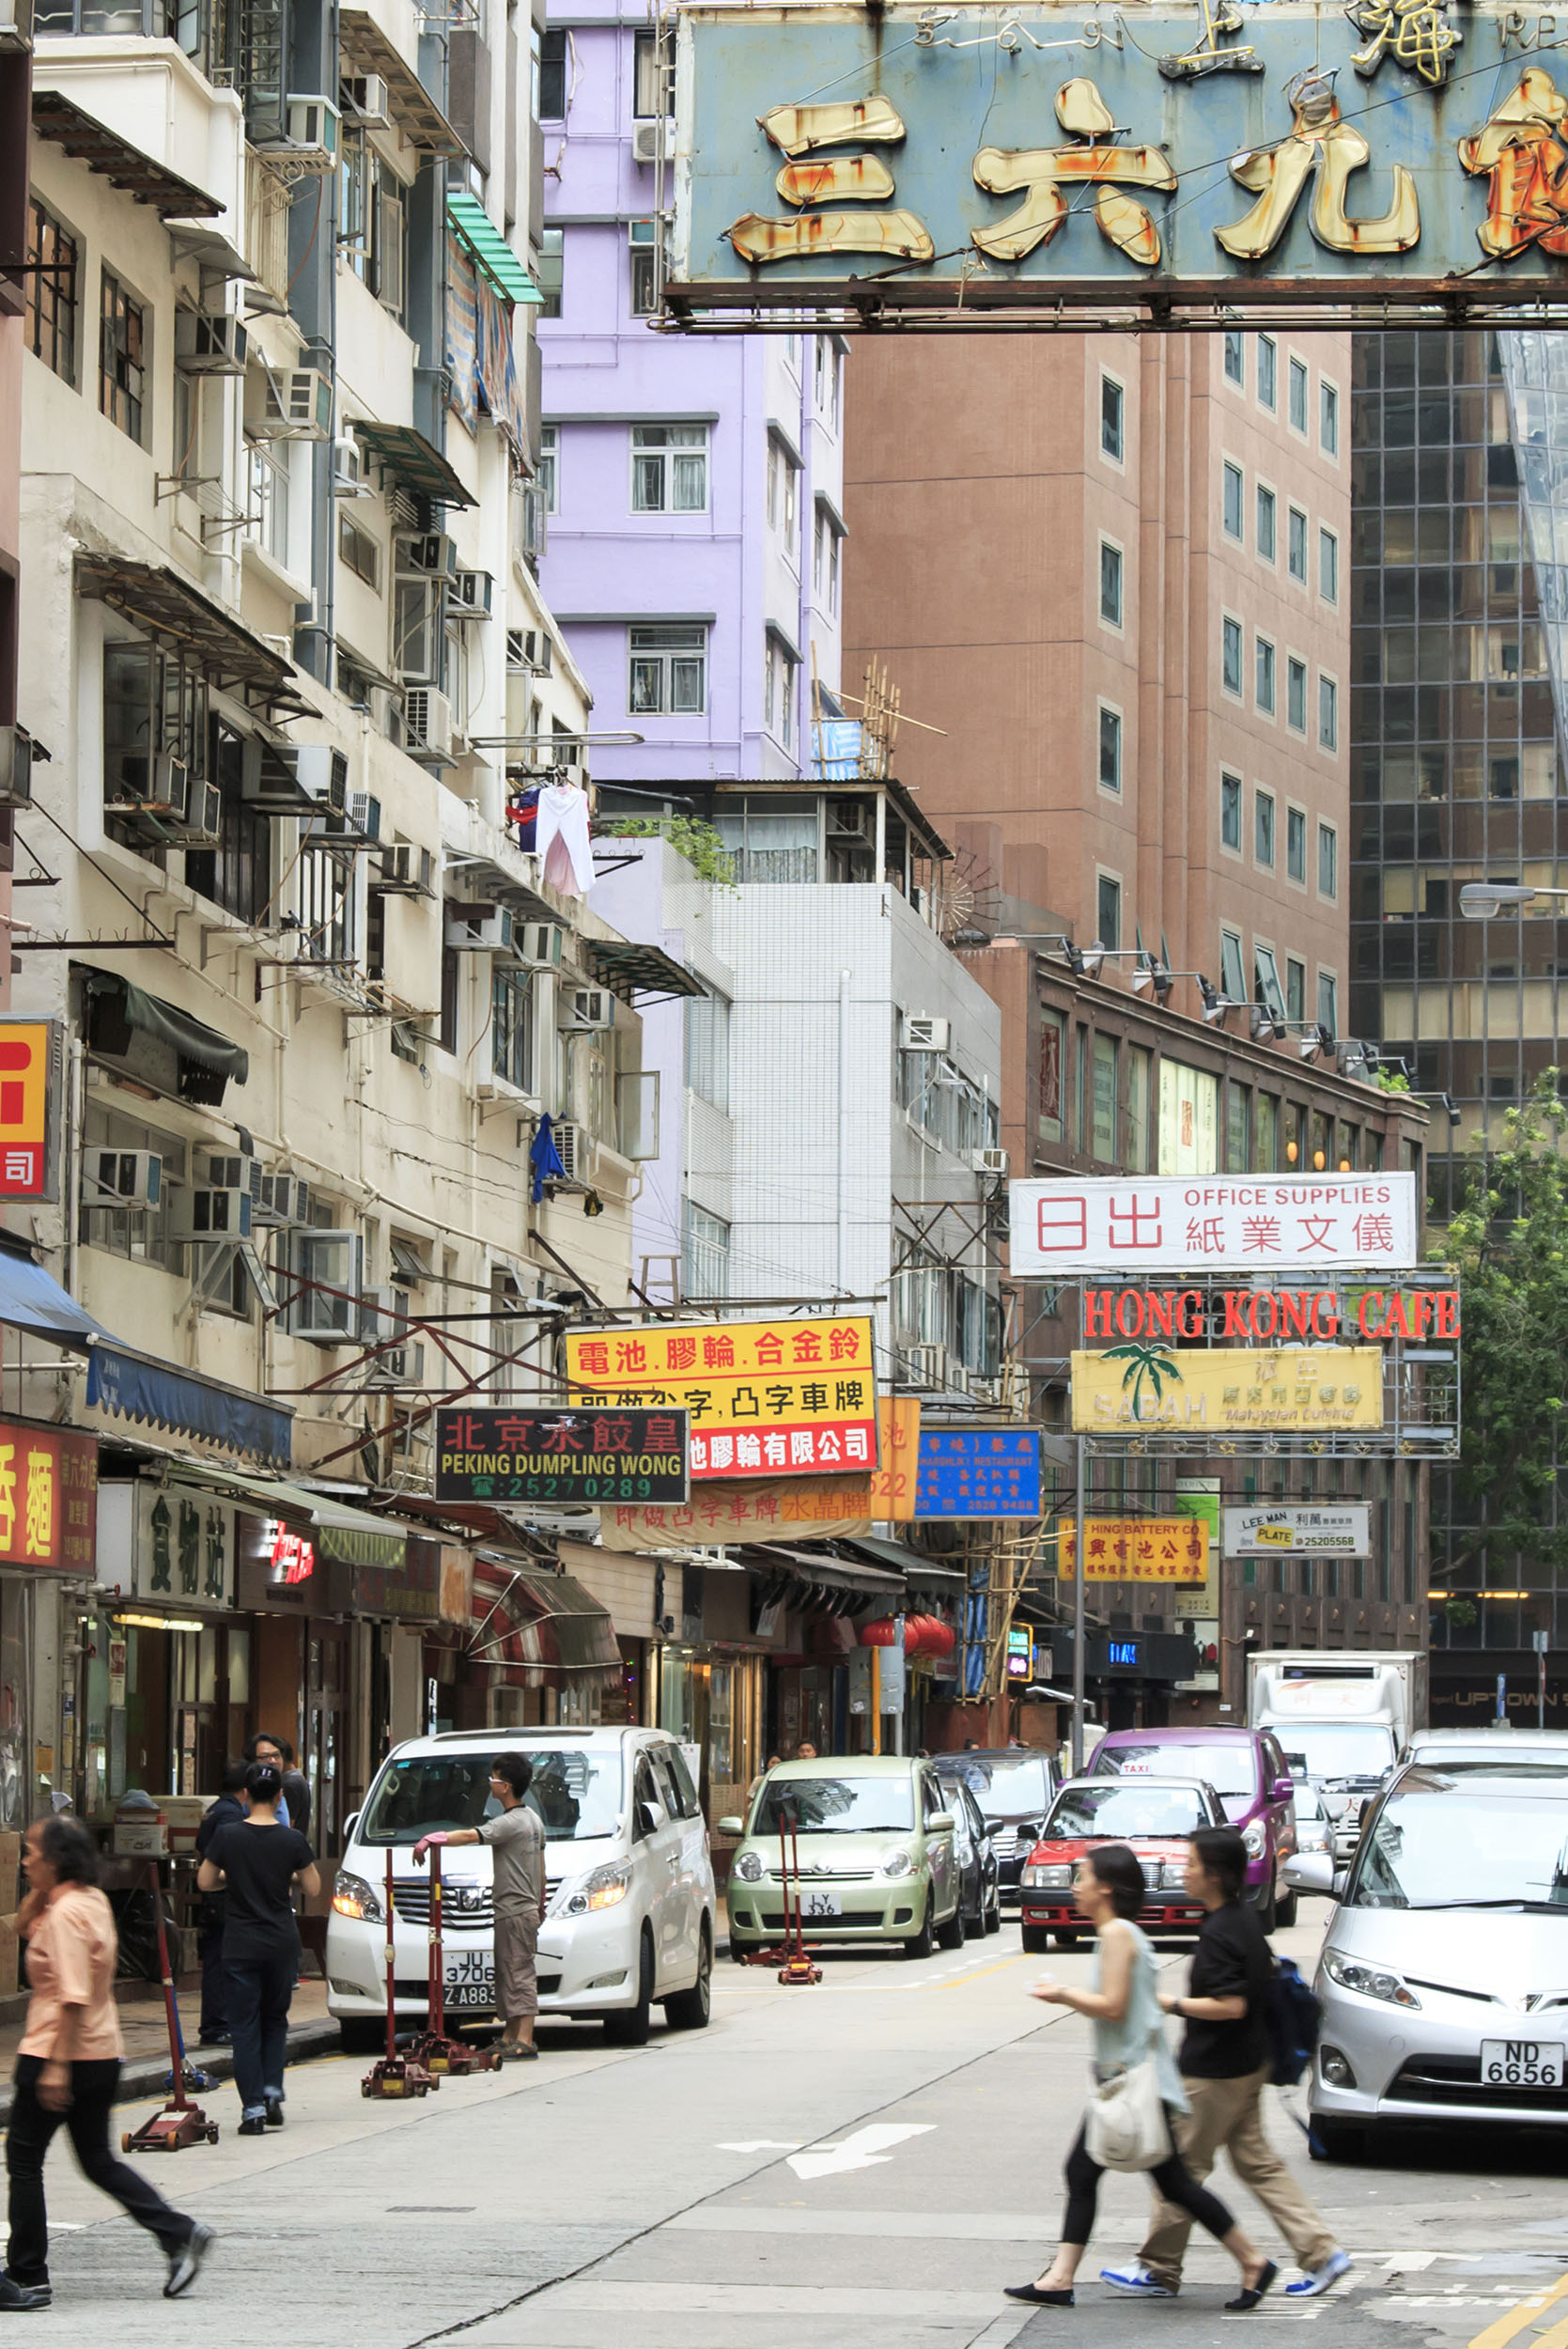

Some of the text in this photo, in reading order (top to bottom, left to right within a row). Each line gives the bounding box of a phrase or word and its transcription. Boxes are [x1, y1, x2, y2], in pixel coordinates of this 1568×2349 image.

[1185, 1186, 1390, 1206] OFFICE SUPPLIES
[1037, 1193, 1162, 1252] 日出
[1187, 1213, 1394, 1254] 紙業文儀
[1083, 1289, 1462, 1339] HONG KONG CAFE
[1094, 1393, 1206, 1423] SABAH
[445, 1415, 681, 1454] 北京水餃皇
[442, 1455, 681, 1476] PEKING DUMPLING WONG
[585, 1478, 651, 1498] 0289
[783, 1493, 870, 1519] 水晶牌
[1092, 1525, 1121, 1534] HING
[1125, 1525, 1178, 1534] BATTERY
[1182, 1525, 1203, 1535] CO.
[1242, 1512, 1287, 1530] LEE MAN
[1258, 1529, 1292, 1542] PLATE
[1305, 1536, 1354, 1546] 25205568
[1124, 1765, 1149, 1773] TAXI
[458, 1952, 483, 1968] JU
[1505, 2042, 1540, 2063] ND
[1487, 2061, 1556, 2085] 6656
